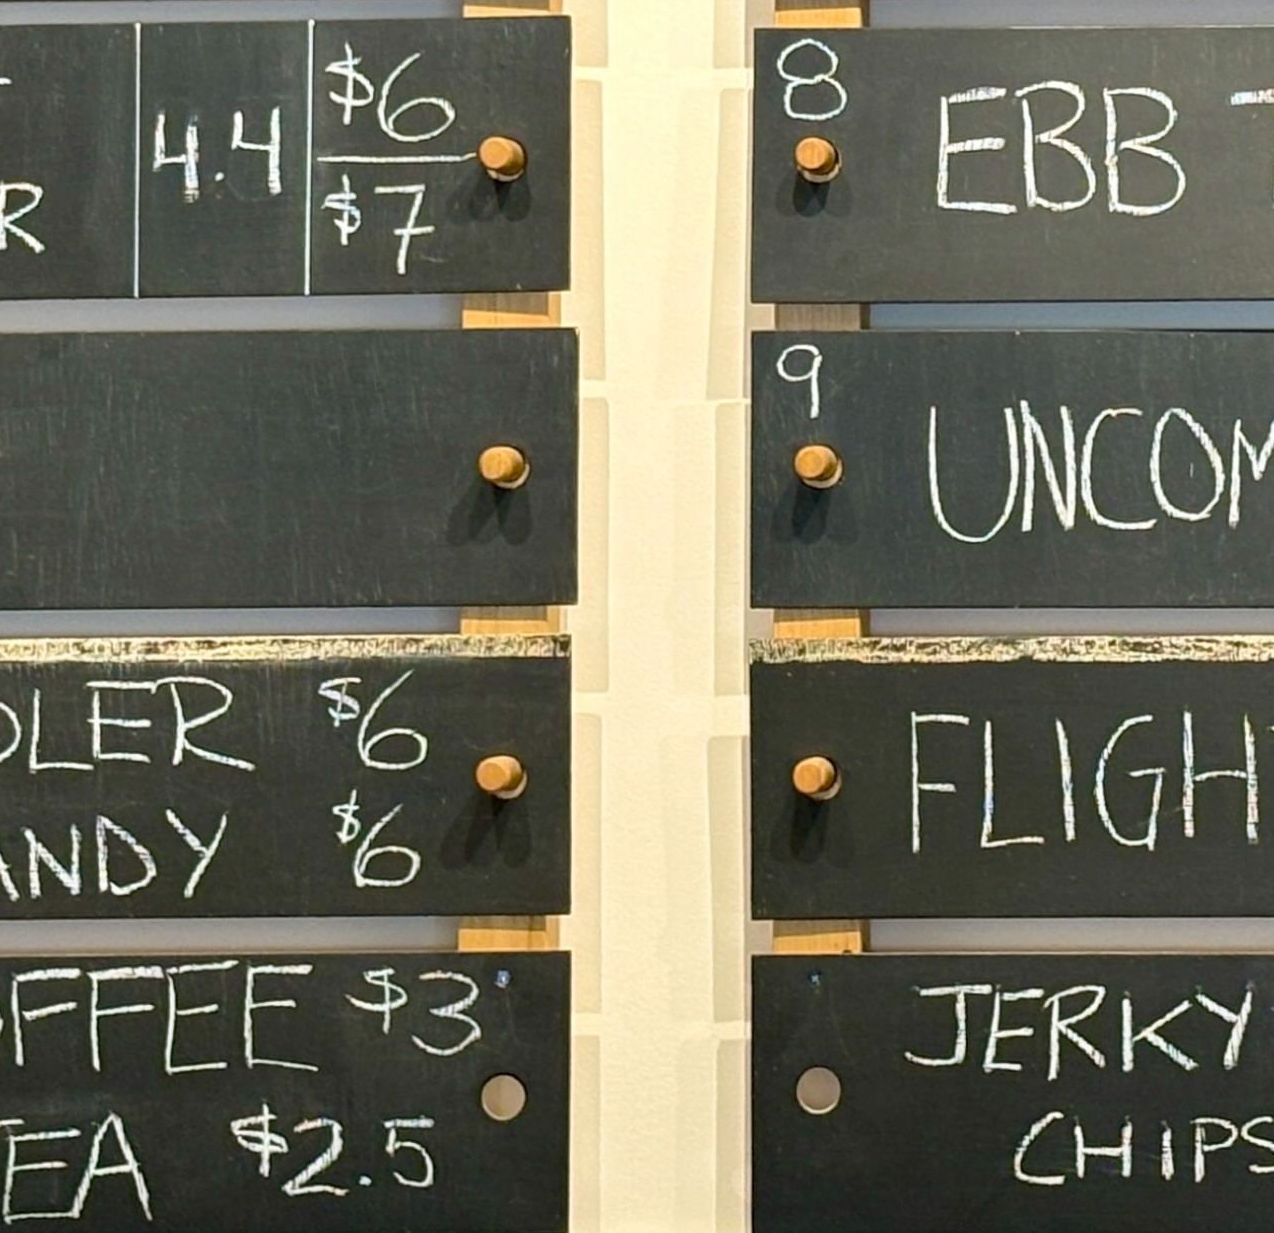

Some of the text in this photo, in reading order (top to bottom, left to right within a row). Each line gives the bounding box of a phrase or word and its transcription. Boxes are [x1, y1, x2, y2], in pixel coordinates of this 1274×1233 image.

[325, 43, 456, 142] $6
[777, 38, 849, 121] 8
[152, 106, 283, 203] 4.4
[936, 80, 1188, 217] EBB
[320, 175, 435, 275] $7
[777, 344, 823, 419] 9
[319, 672, 428, 771] $6
[332, 790, 421, 889] $6
[345, 969, 483, 1057] $3
[905, 981, 1255, 1079] JERKY
[231, 1104, 435, 1196] $2.5
